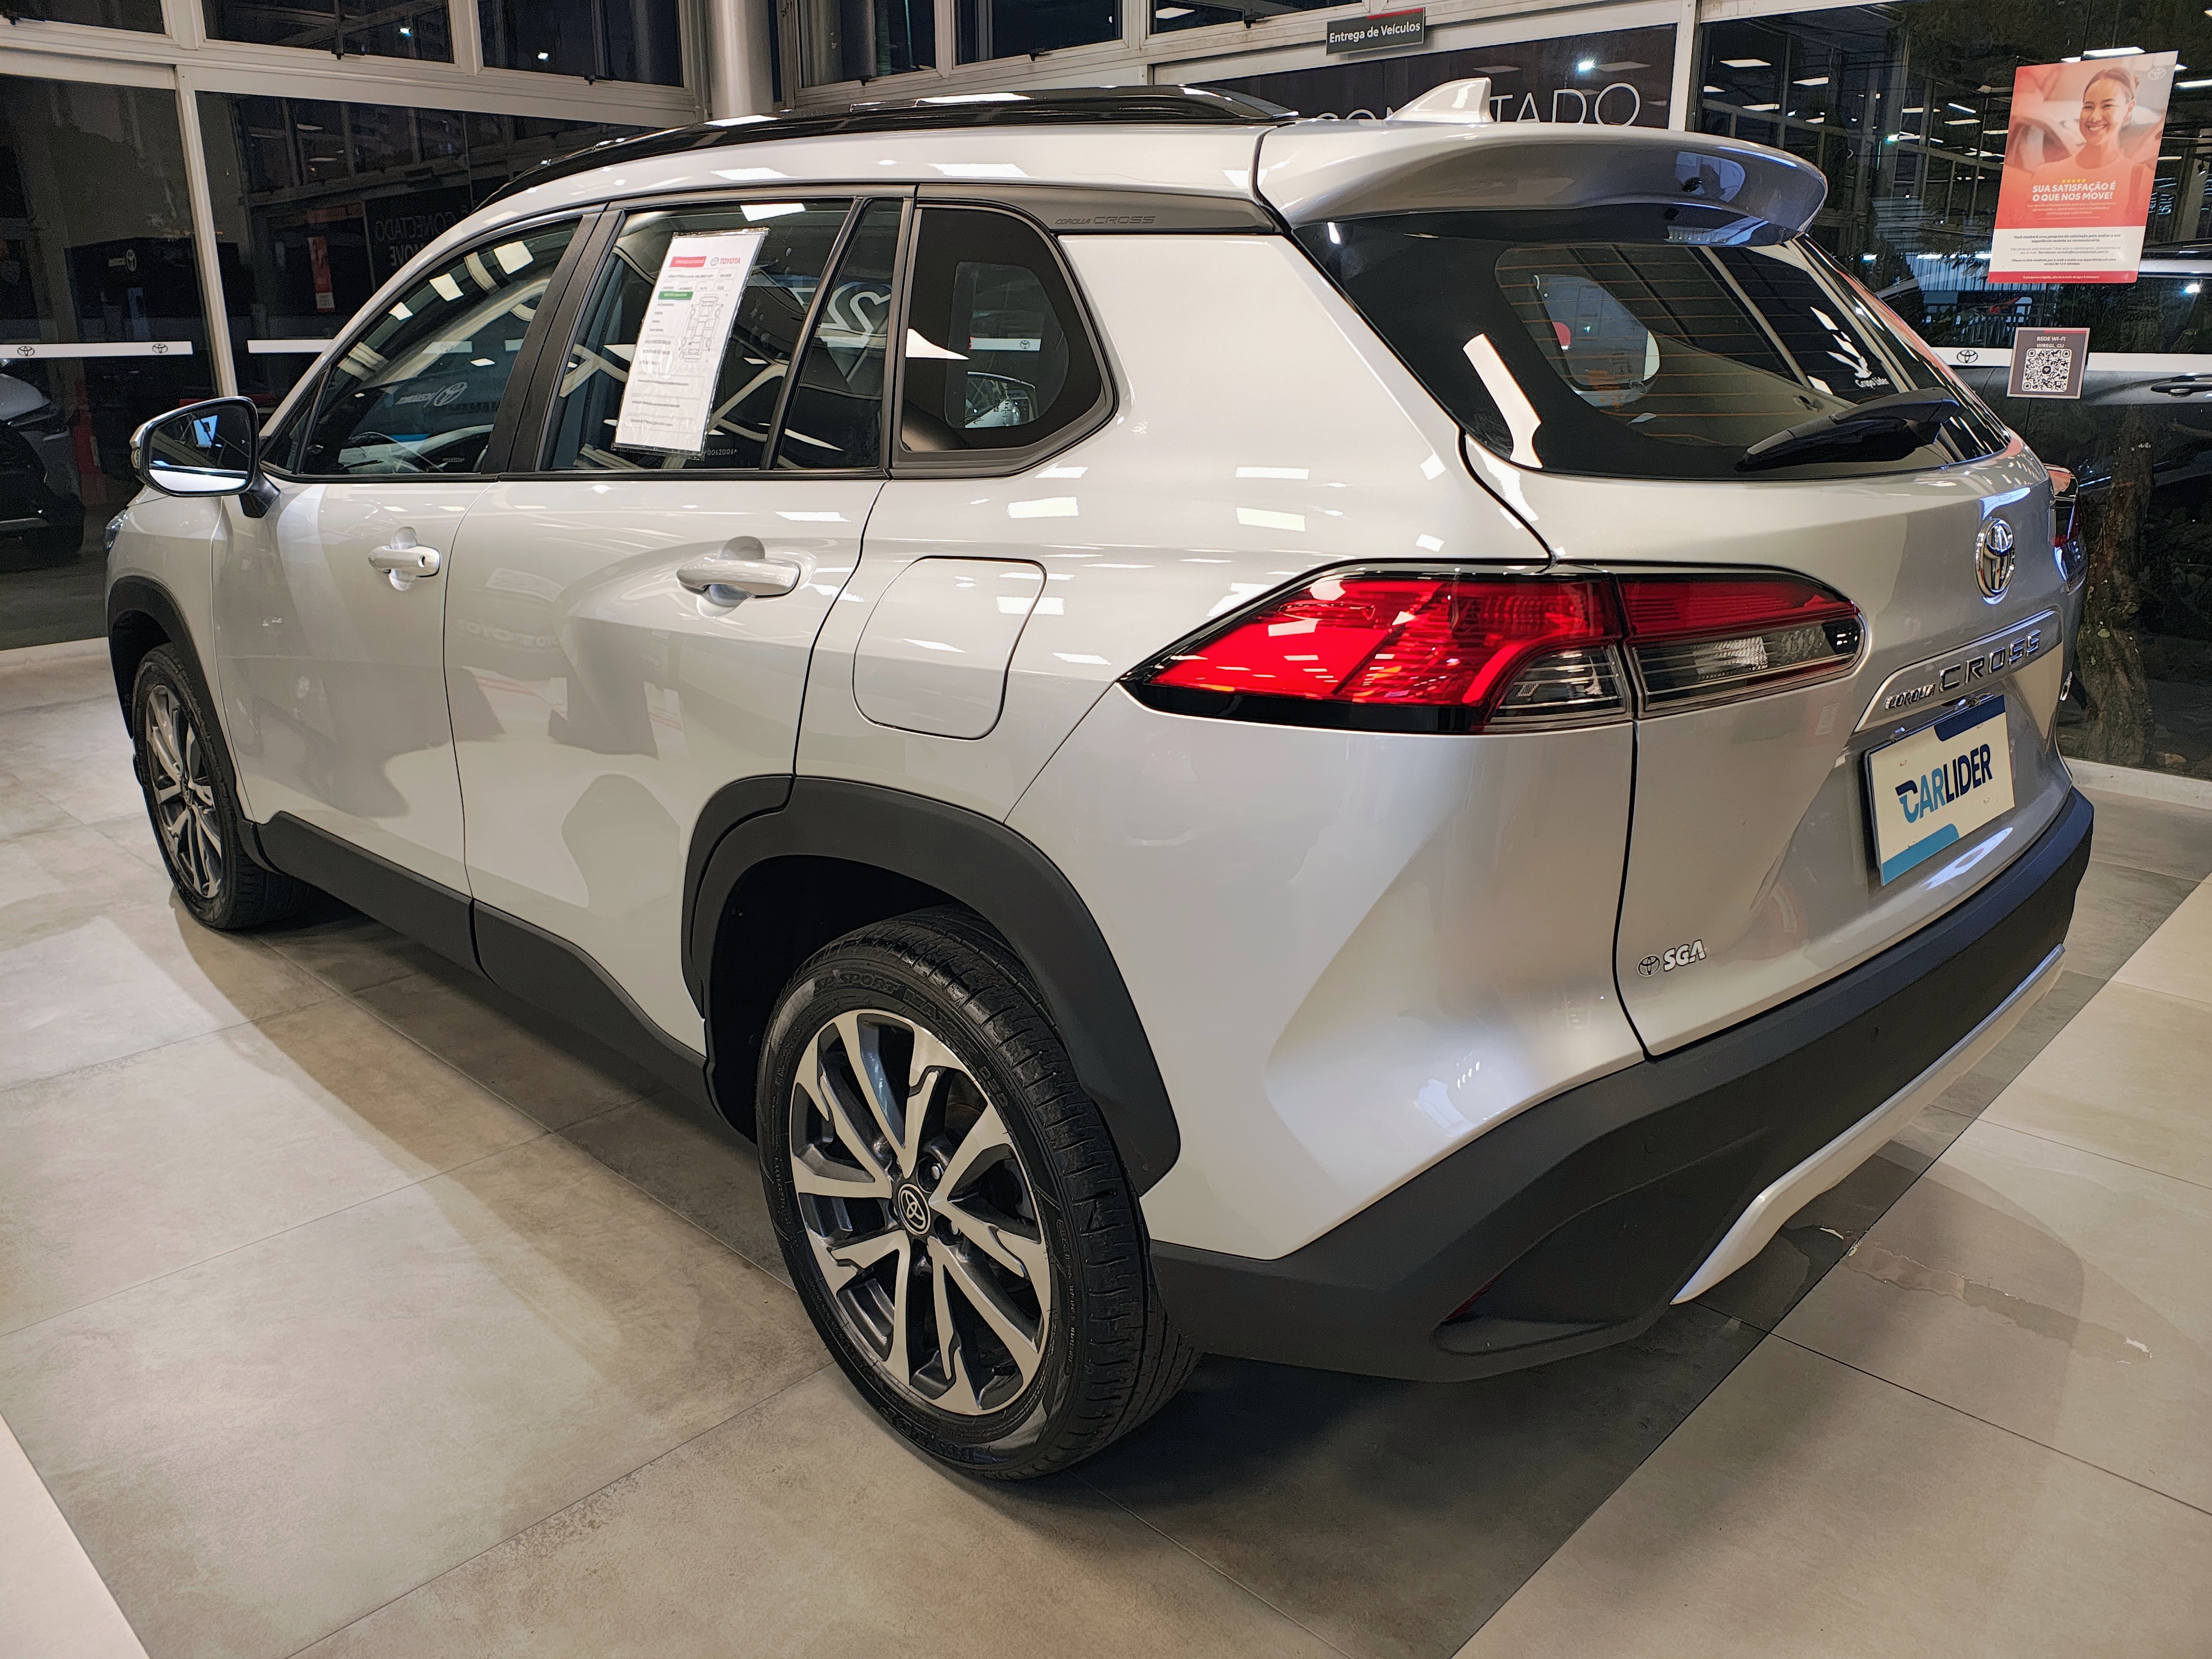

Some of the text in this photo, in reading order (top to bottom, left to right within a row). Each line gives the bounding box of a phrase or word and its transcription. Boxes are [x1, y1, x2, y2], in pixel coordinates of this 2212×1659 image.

[1329, 21, 1421, 43] Entrega de Veículos
[2032, 180, 2116, 193] SUA SATISFAÇÃO É
[2032, 192, 2114, 202] O QUE NOS MOVE!
[1093, 216, 1156, 224] CROSS
[1885, 629, 2041, 710] COROLLA CROSS
[1895, 743, 1993, 823] CARLIDER
[1663, 939, 1707, 972] SGA
[838, 972, 901, 994] SPORT
